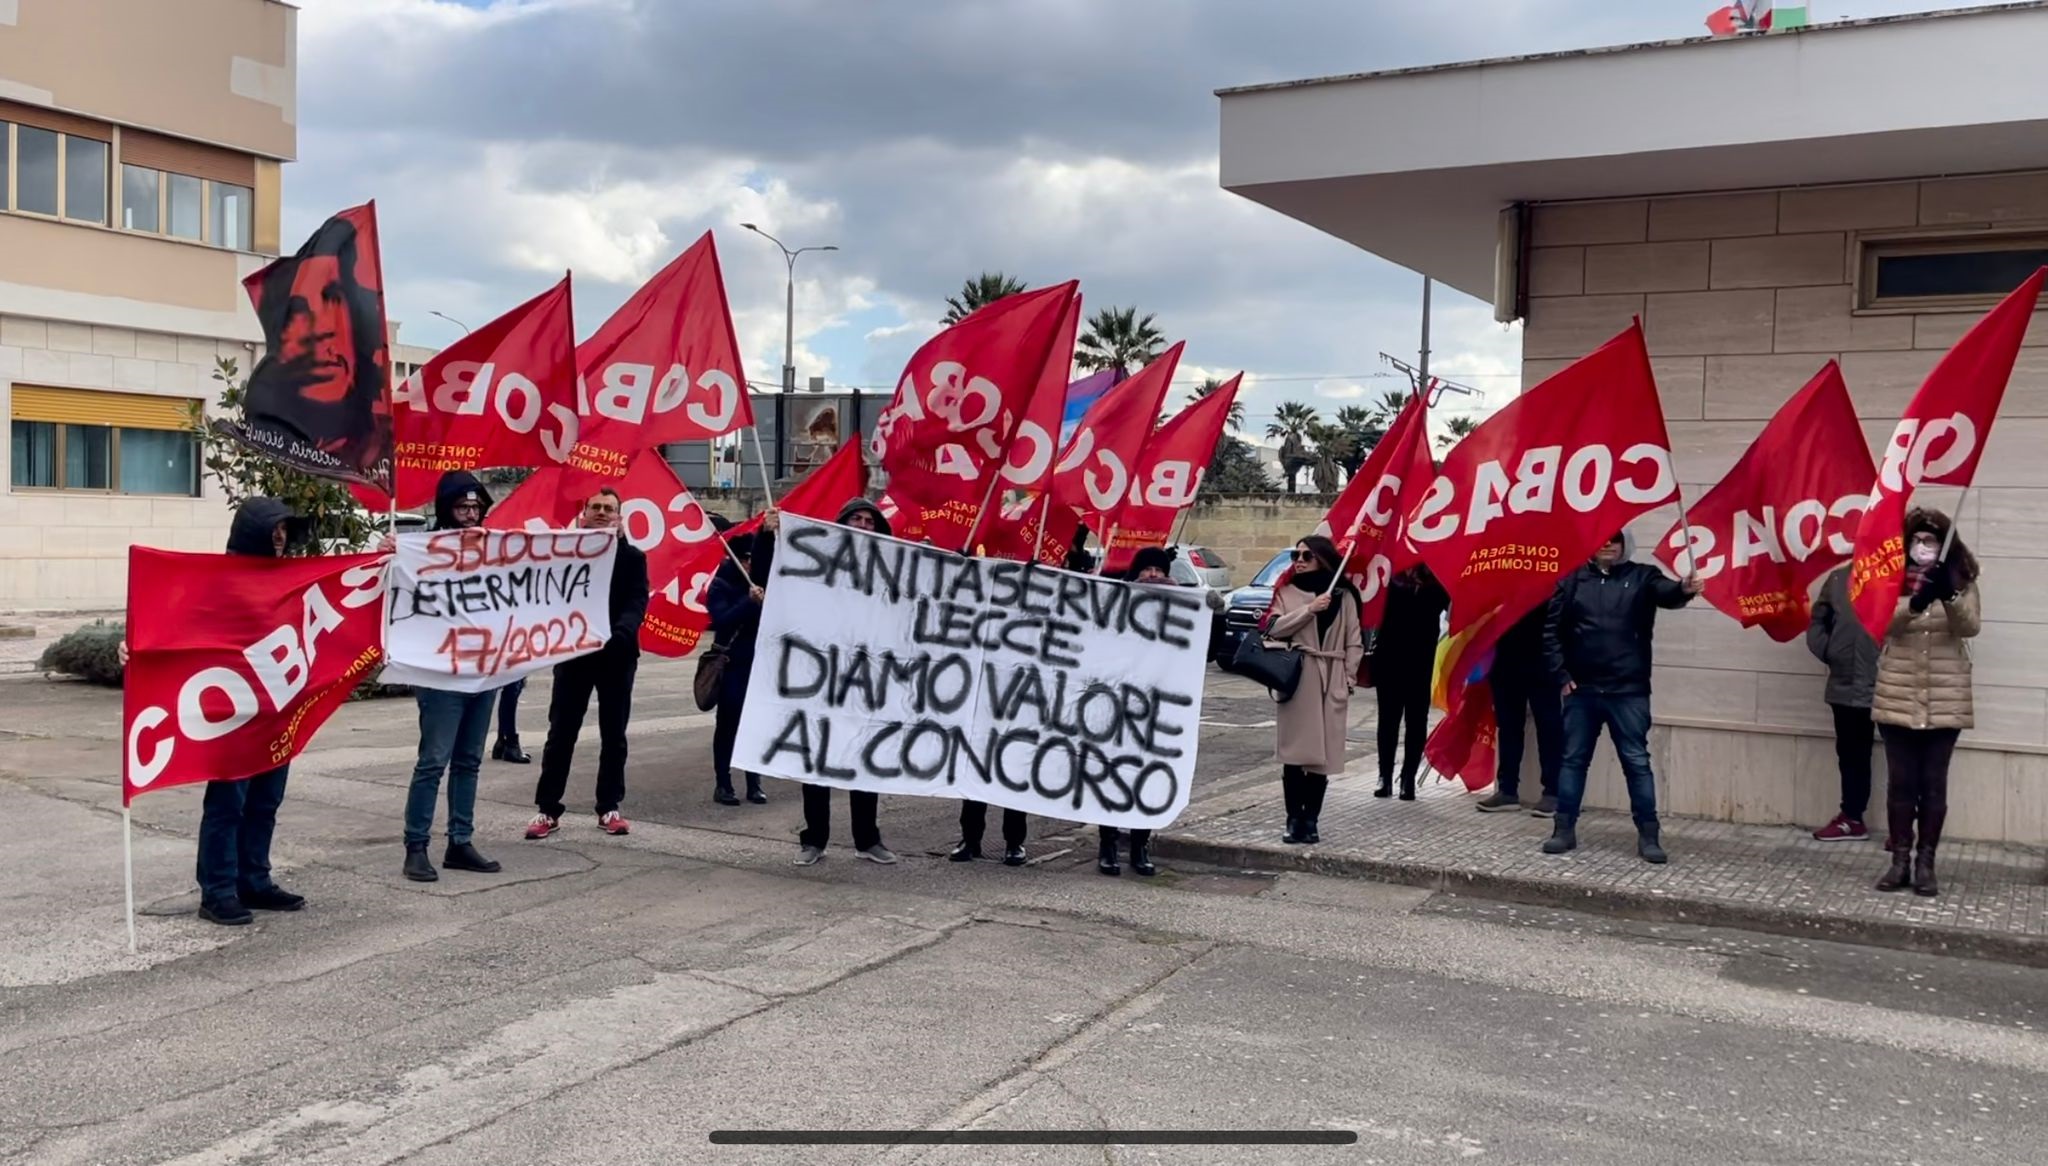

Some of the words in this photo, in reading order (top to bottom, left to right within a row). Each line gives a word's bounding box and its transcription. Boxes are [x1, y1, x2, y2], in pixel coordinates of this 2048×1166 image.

[389, 563, 591, 626] DETERMINA
[417, 527, 614, 575] SBLOCCO
[779, 526, 1200, 649] SANITASERVICE
[127, 555, 391, 789] COBAS
[436, 611, 603, 676] 17/2022
[913, 600, 1084, 668] LECCE
[778, 633, 973, 715] DIAMO
[986, 660, 1193, 759] VALORE
[760, 709, 856, 780] AL
[861, 717, 1178, 817] CONCORSO
